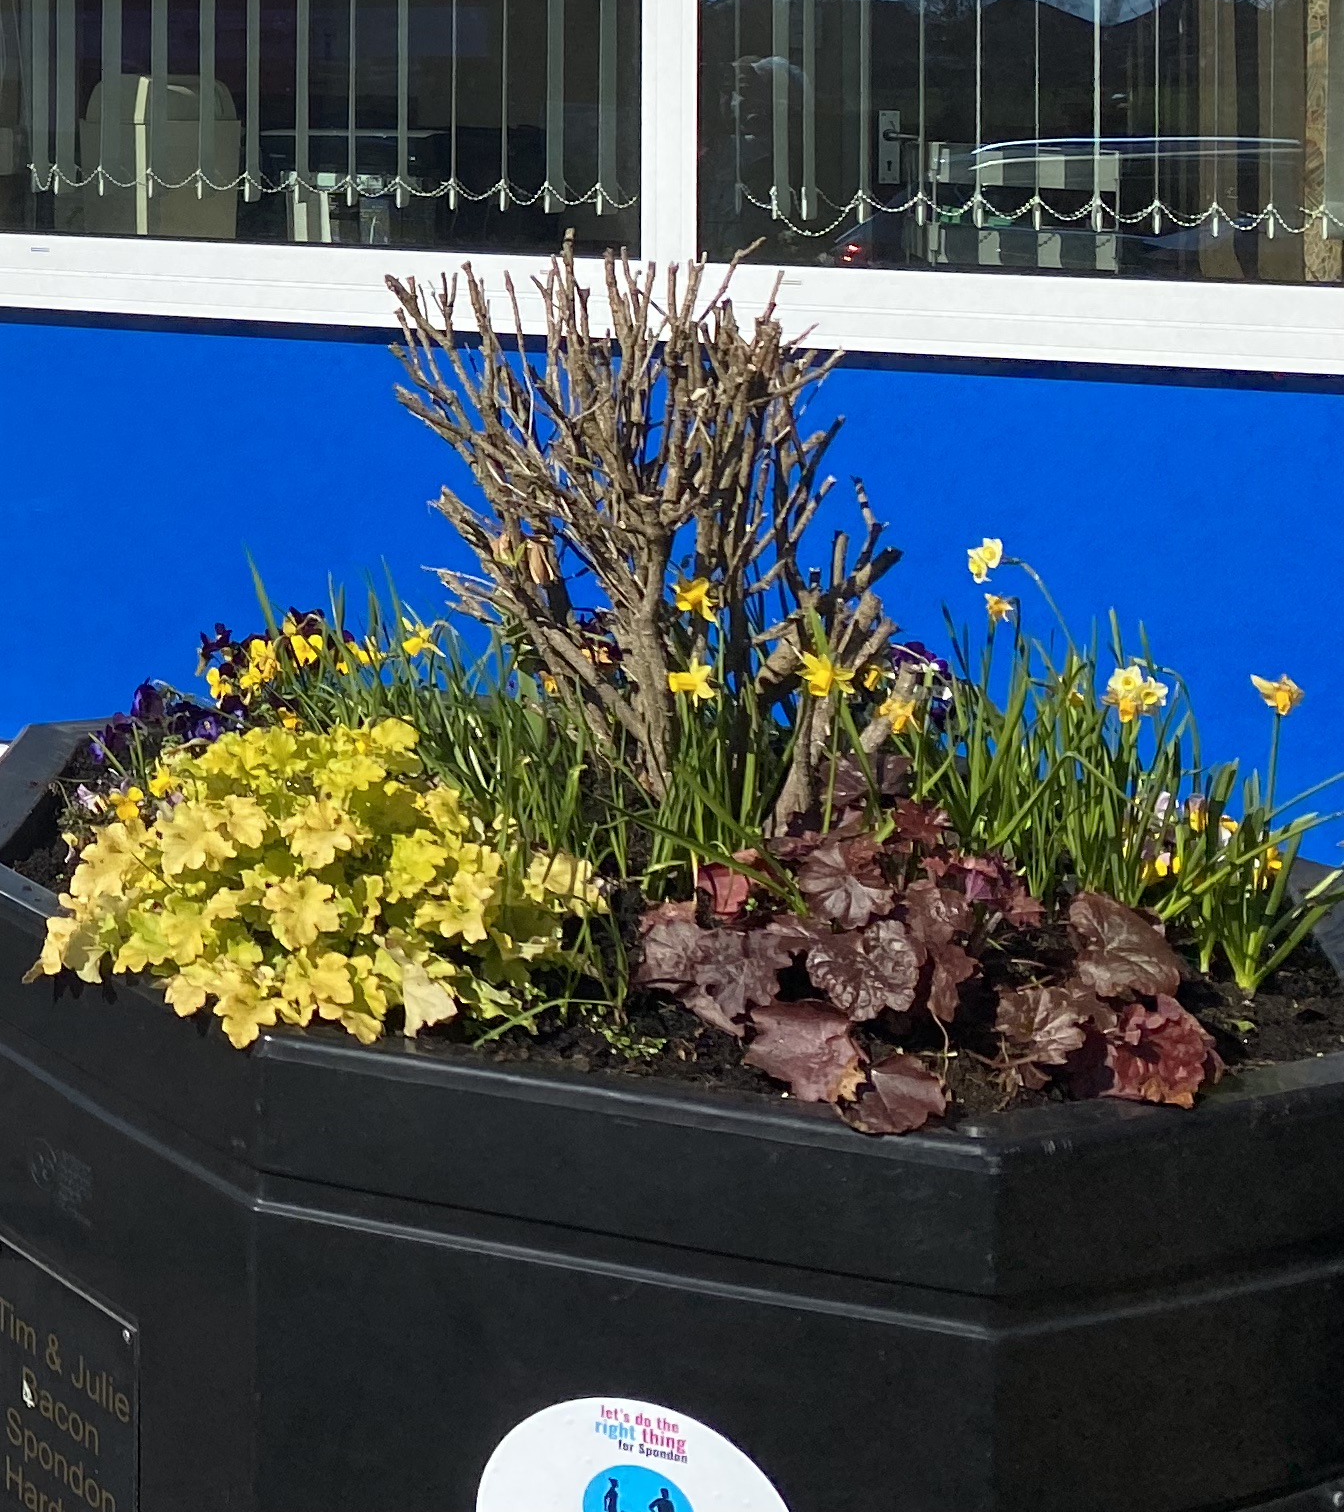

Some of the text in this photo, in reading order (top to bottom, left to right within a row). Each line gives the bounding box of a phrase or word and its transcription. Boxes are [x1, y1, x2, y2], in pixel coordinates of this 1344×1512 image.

[45, 1333, 62, 1376] &
[71, 1355, 130, 1424] Julie
[22, 1365, 99, 1456] Bacon
[595, 1419, 686, 1454] right thing
[600, 1404, 679, 1434] let's do the
[6, 1406, 116, 1512] Spondon
[618, 1439, 688, 1464] for Spondon
